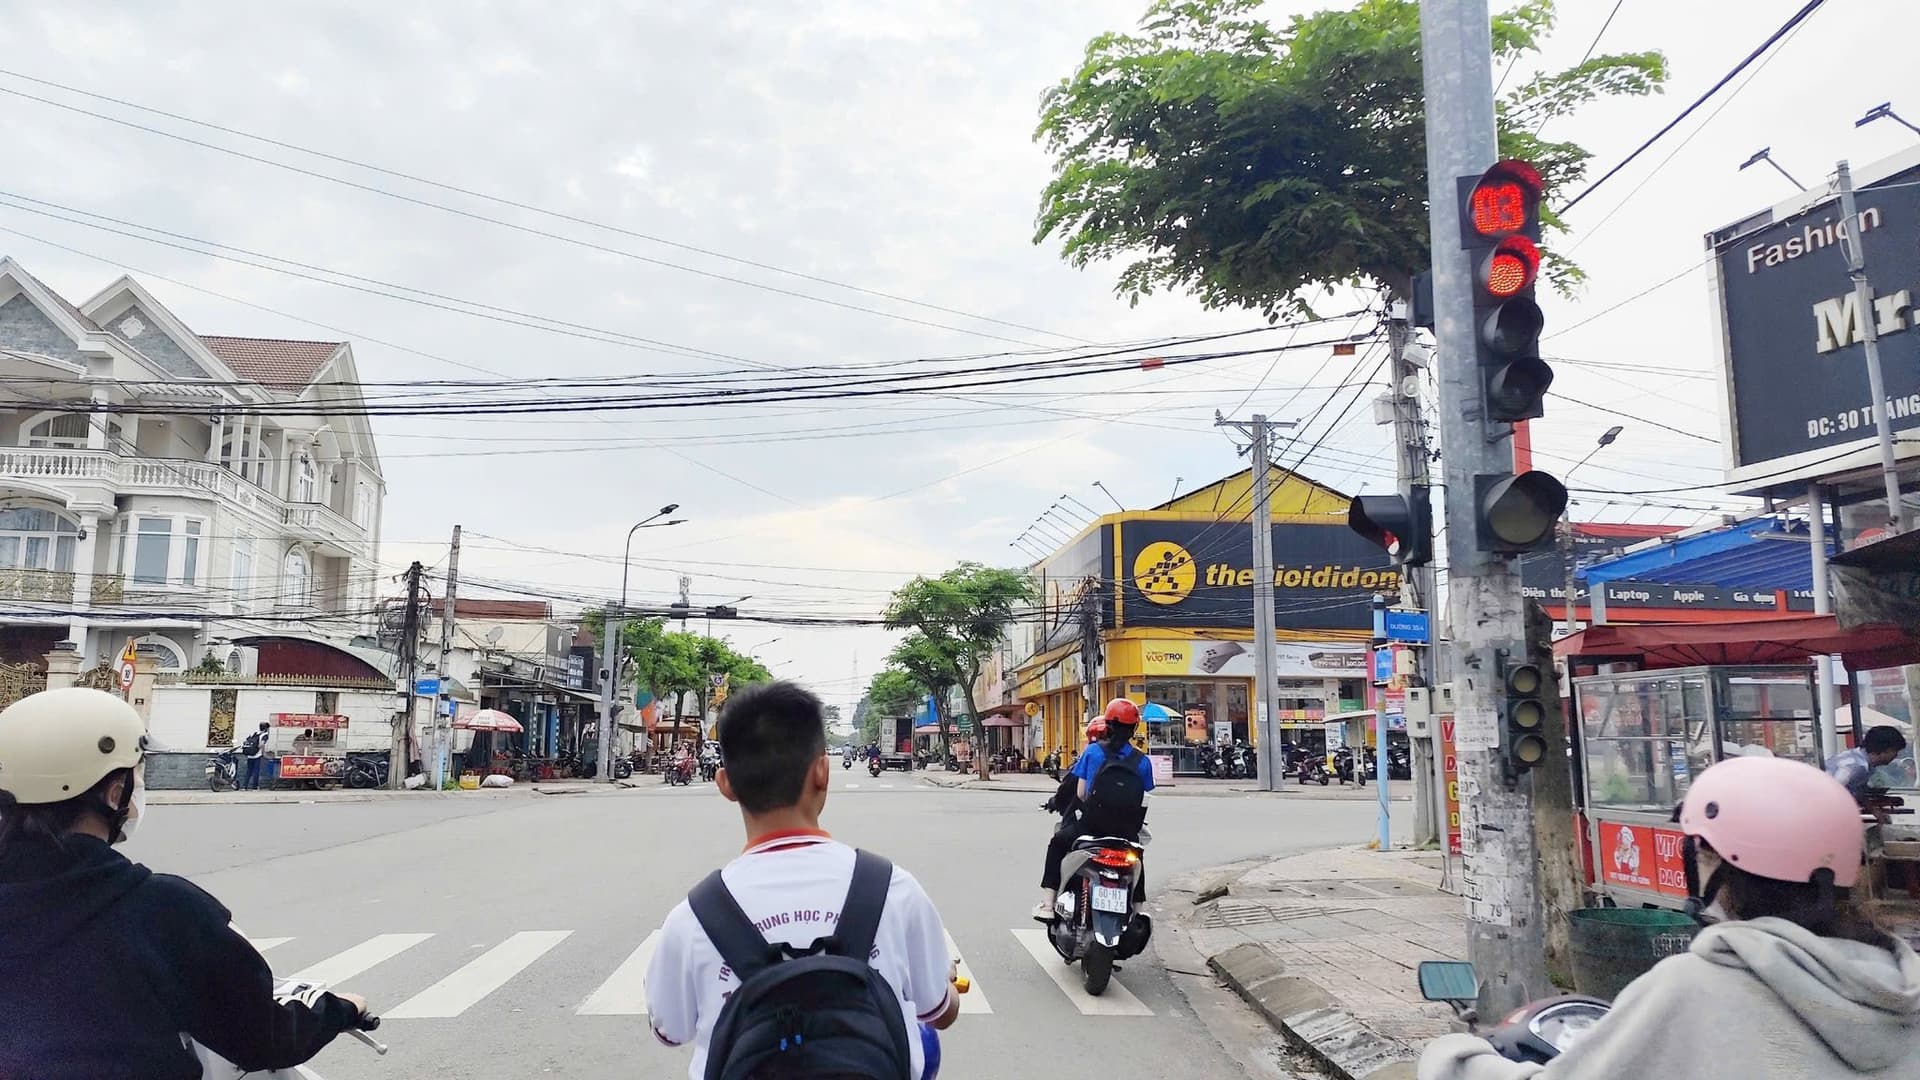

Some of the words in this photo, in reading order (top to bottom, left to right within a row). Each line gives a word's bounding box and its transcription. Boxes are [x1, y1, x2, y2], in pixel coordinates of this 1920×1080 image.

[1747, 206, 1880, 275] Fashion
[1837, 409, 1859, 431] 30
[1609, 588, 1650, 602] Laptop
[1673, 590, 1705, 603] Apple
[794, 910, 820, 925] HỌC
